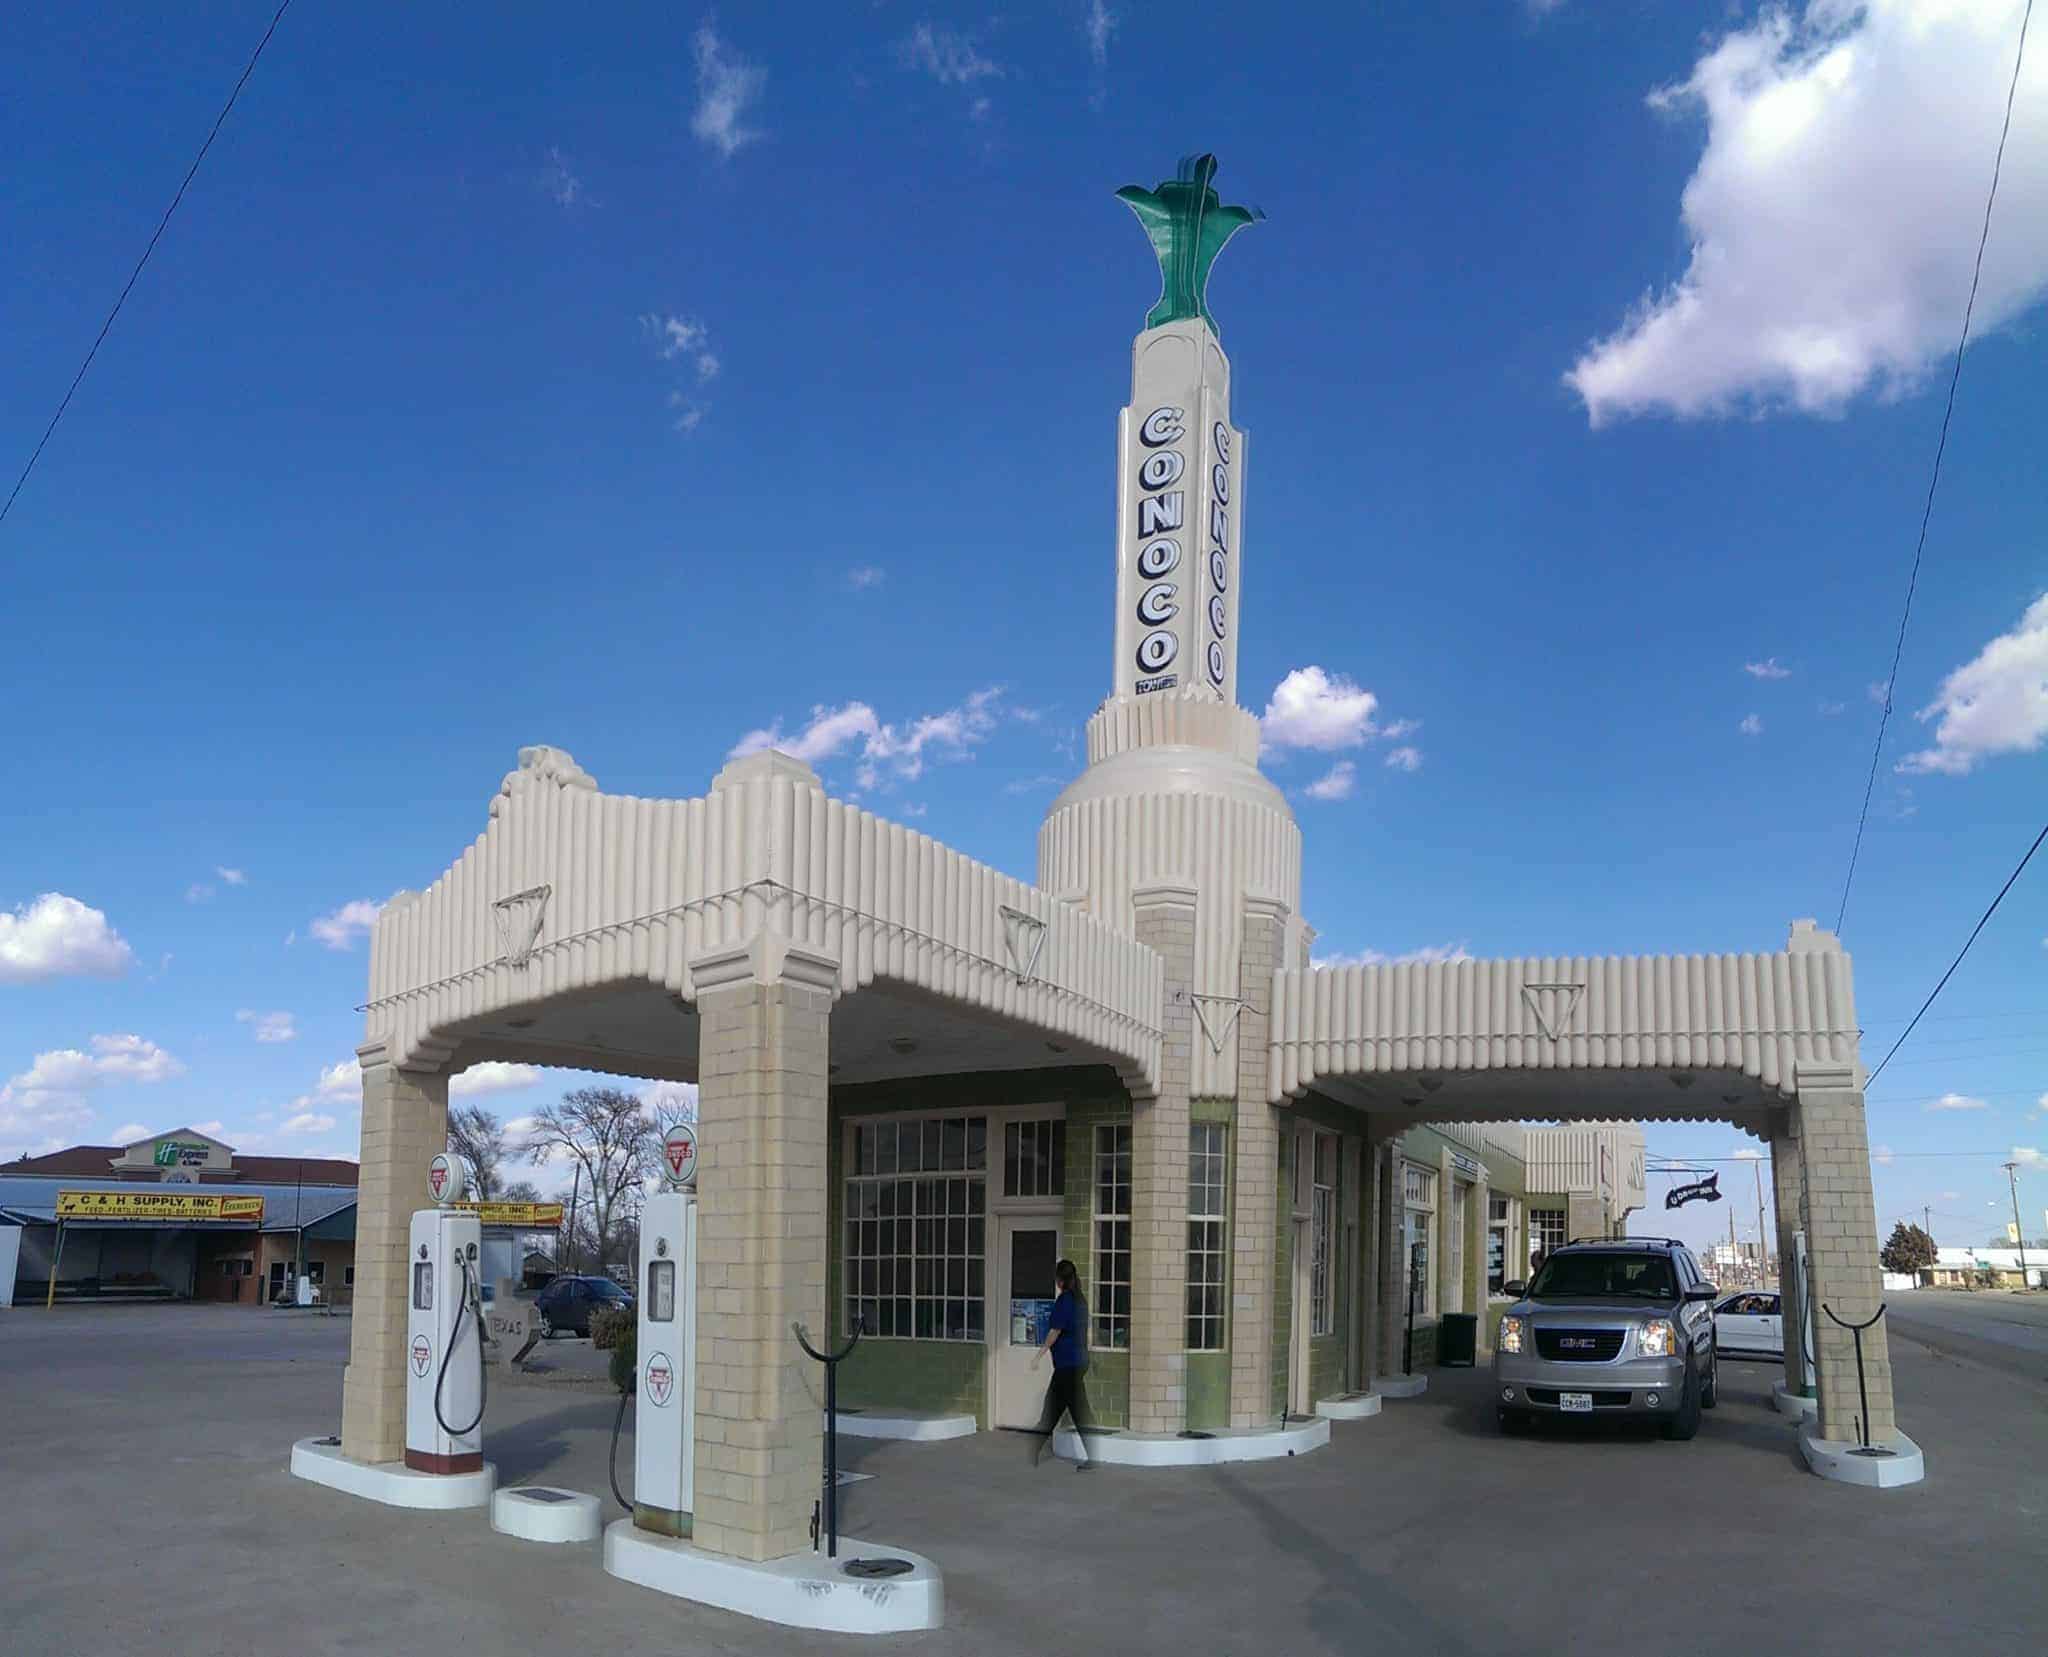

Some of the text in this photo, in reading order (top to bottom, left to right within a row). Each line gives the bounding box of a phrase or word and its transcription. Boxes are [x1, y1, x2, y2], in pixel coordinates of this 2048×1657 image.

[1136, 407, 1186, 674] CONOCO
[1207, 421, 1230, 685] CONOCO
[81, 1195, 218, 1208] C & H SUPPLY, INC.
[1559, 1337, 1596, 1348] GMC
